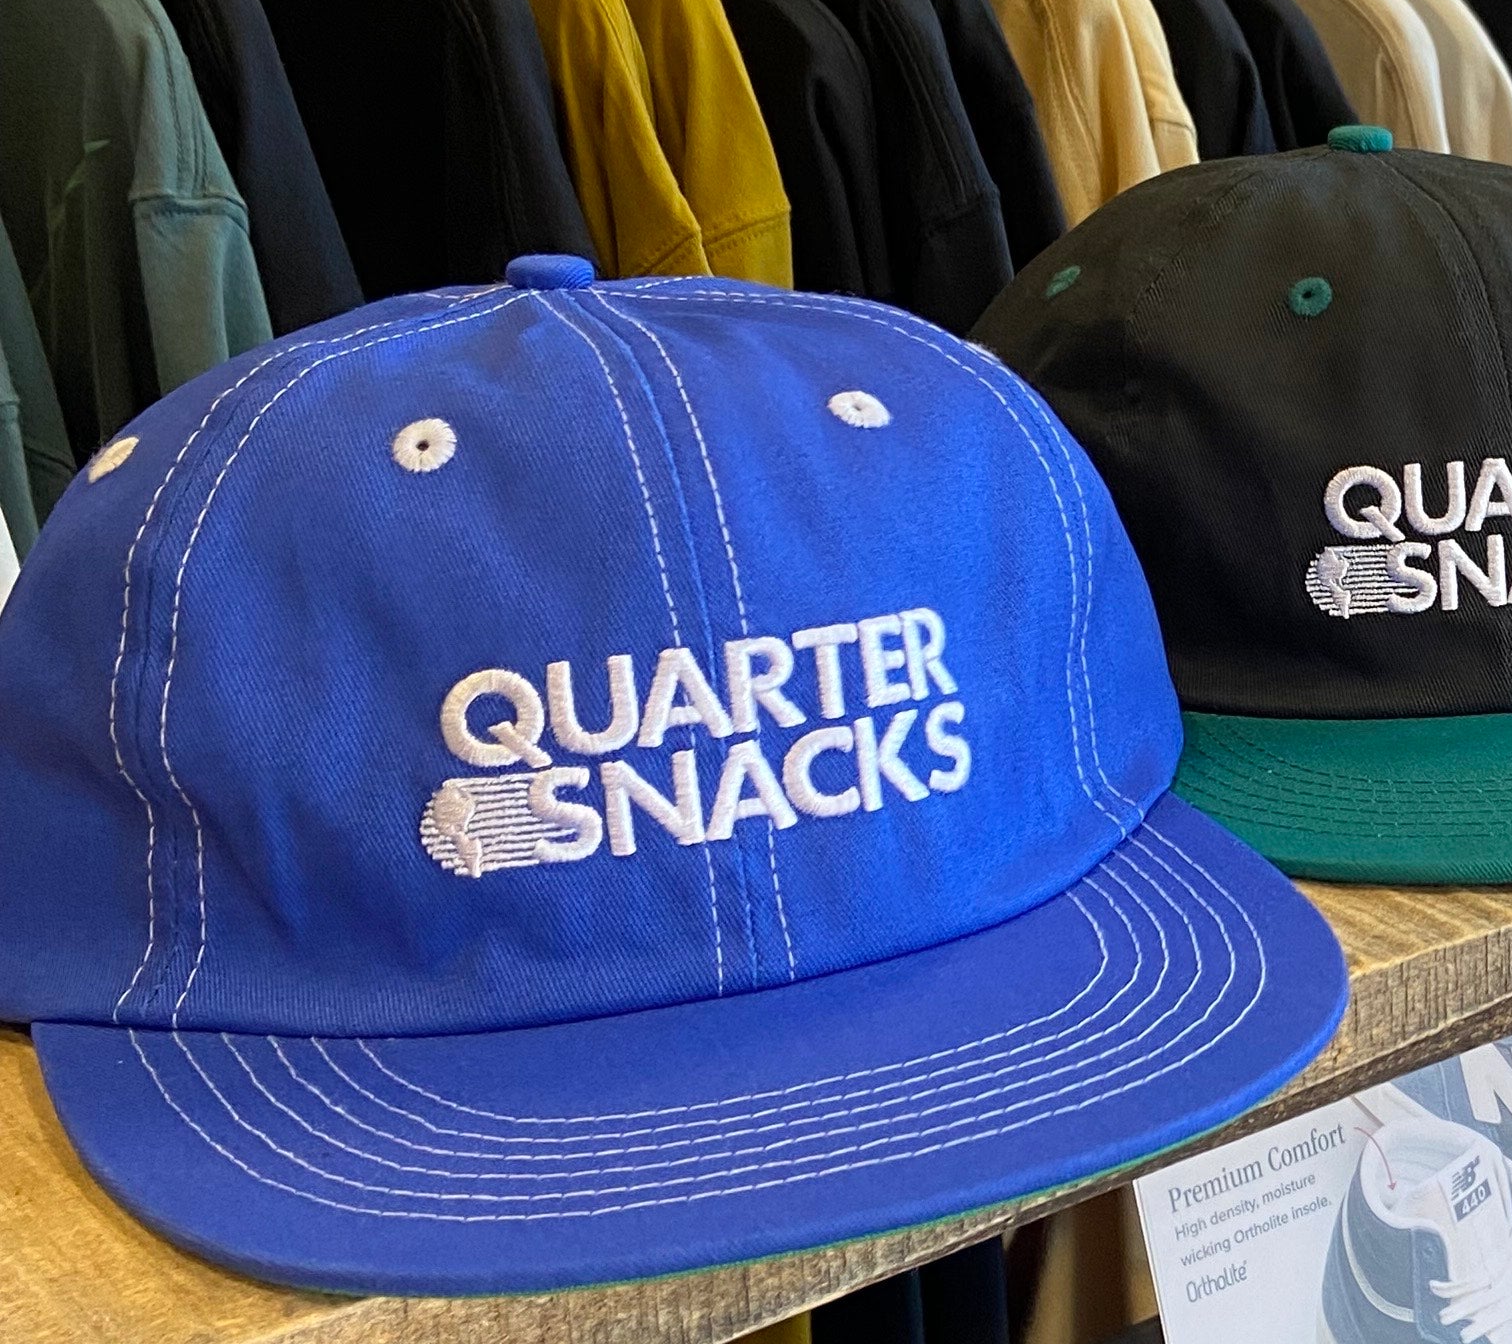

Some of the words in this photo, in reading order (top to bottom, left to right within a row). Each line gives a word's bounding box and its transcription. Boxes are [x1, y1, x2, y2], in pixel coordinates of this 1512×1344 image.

[440, 607, 958, 768] QUARTER
[528, 701, 972, 862] SNACKS
[1167, 1158, 1264, 1214] Premium
[1266, 1123, 1346, 1172] Comfort
[1174, 1218, 1208, 1241] High
[1210, 1198, 1260, 1226] density,
[1262, 1173, 1317, 1205] moisture
[1461, 1186, 1487, 1216] 440
[1180, 1237, 1232, 1268] wicking
[1234, 1212, 1290, 1244] Ortholite
[1291, 1194, 1333, 1221] insole.
